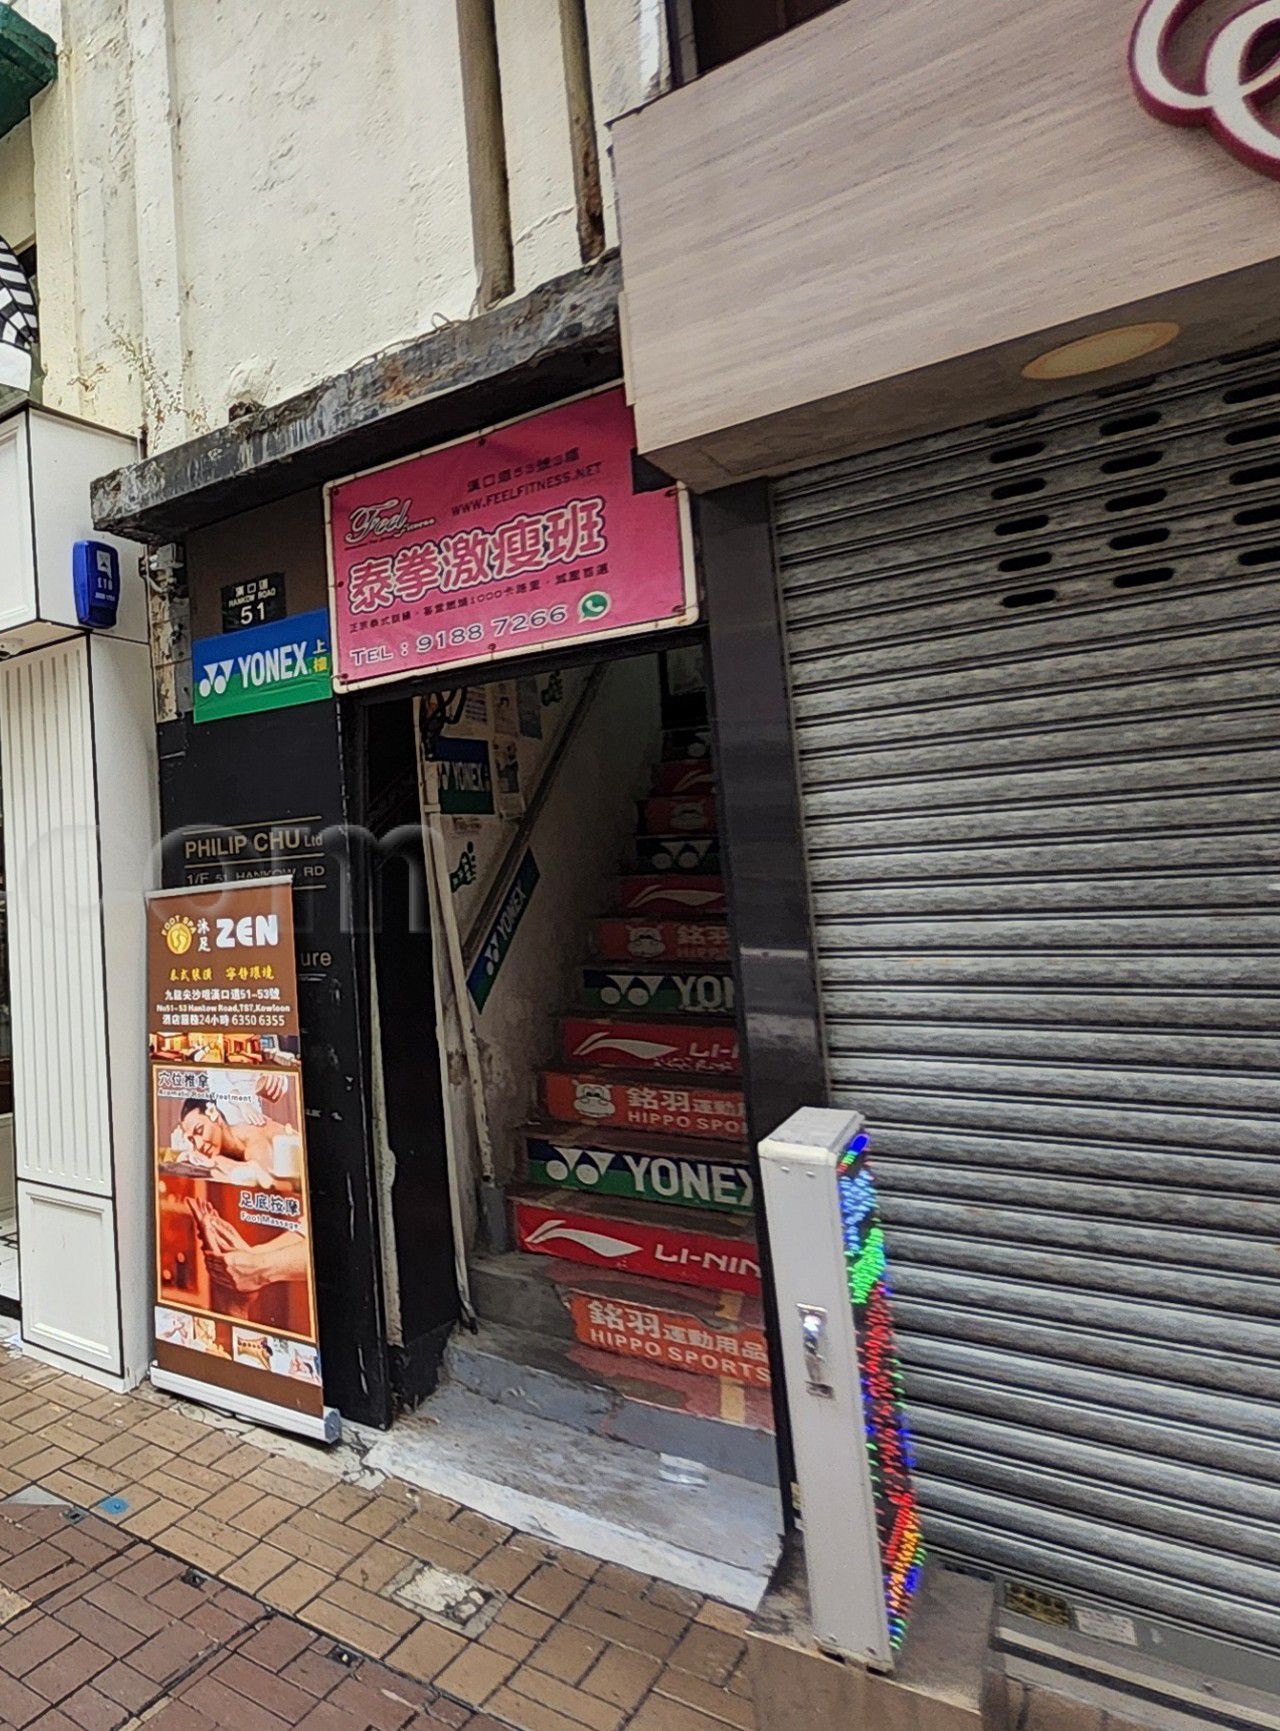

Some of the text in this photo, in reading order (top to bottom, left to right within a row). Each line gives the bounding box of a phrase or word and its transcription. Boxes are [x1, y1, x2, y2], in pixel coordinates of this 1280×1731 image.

[349, 497, 606, 613] 泰拳激瘦班
[257, 587, 276, 600] ROAD
[240, 602, 265, 625] 51
[416, 624, 484, 654] 9188
[492, 604, 568, 637] 7266
[237, 641, 308, 688] YONEX
[185, 829, 323, 859] PHILIP CHU Ltd
[186, 872, 209, 885] 1/F
[303, 866, 325, 877] RD
[161, 914, 197, 936] FOOT SPA
[197, 918, 211, 952] 沐足
[216, 913, 279, 948] ZEN
[232, 1014, 257, 1026] 6350
[258, 1014, 285, 1026] 6355
[159, 1071, 209, 1088] 穴位推拿
[626, 1086, 745, 1117] 銘羽運動
[627, 1110, 746, 1135] HIPPO SPO
[240, 1191, 299, 1215] 足底按摩
[654, 1243, 761, 1279] LI-NIN
[589, 1328, 771, 1383] HIPPO SPORTS
